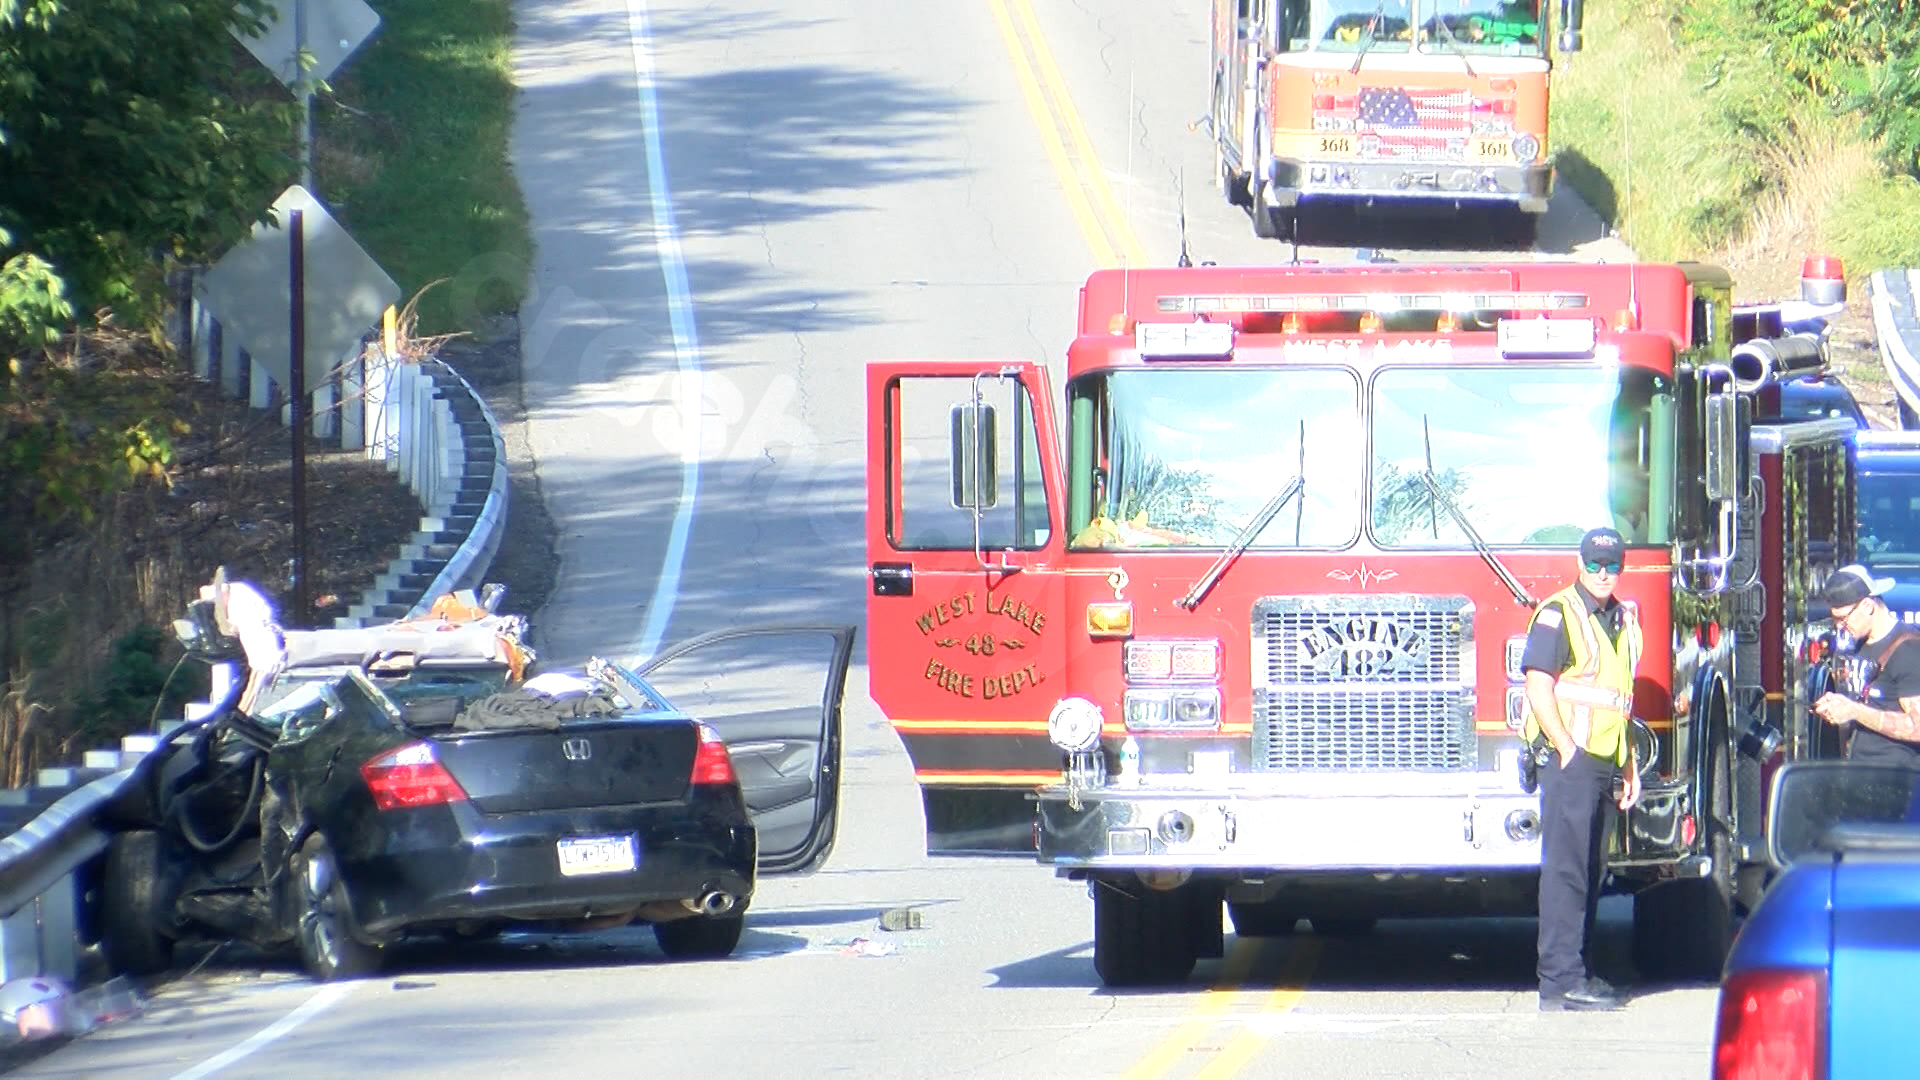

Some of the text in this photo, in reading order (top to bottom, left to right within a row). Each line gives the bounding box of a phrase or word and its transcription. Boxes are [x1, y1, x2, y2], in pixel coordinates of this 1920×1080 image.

[1320, 137, 1349, 152] 368
[1478, 141, 1508, 156] 368
[1283, 339, 1363, 361] WEST
[915, 590, 1046, 636] WEST LAKE
[965, 633, 995, 656] 48
[1301, 619, 1426, 659] ENGINE
[1330, 649, 1396, 676] 482
[925, 657, 1046, 700] FIRE DEPT.
